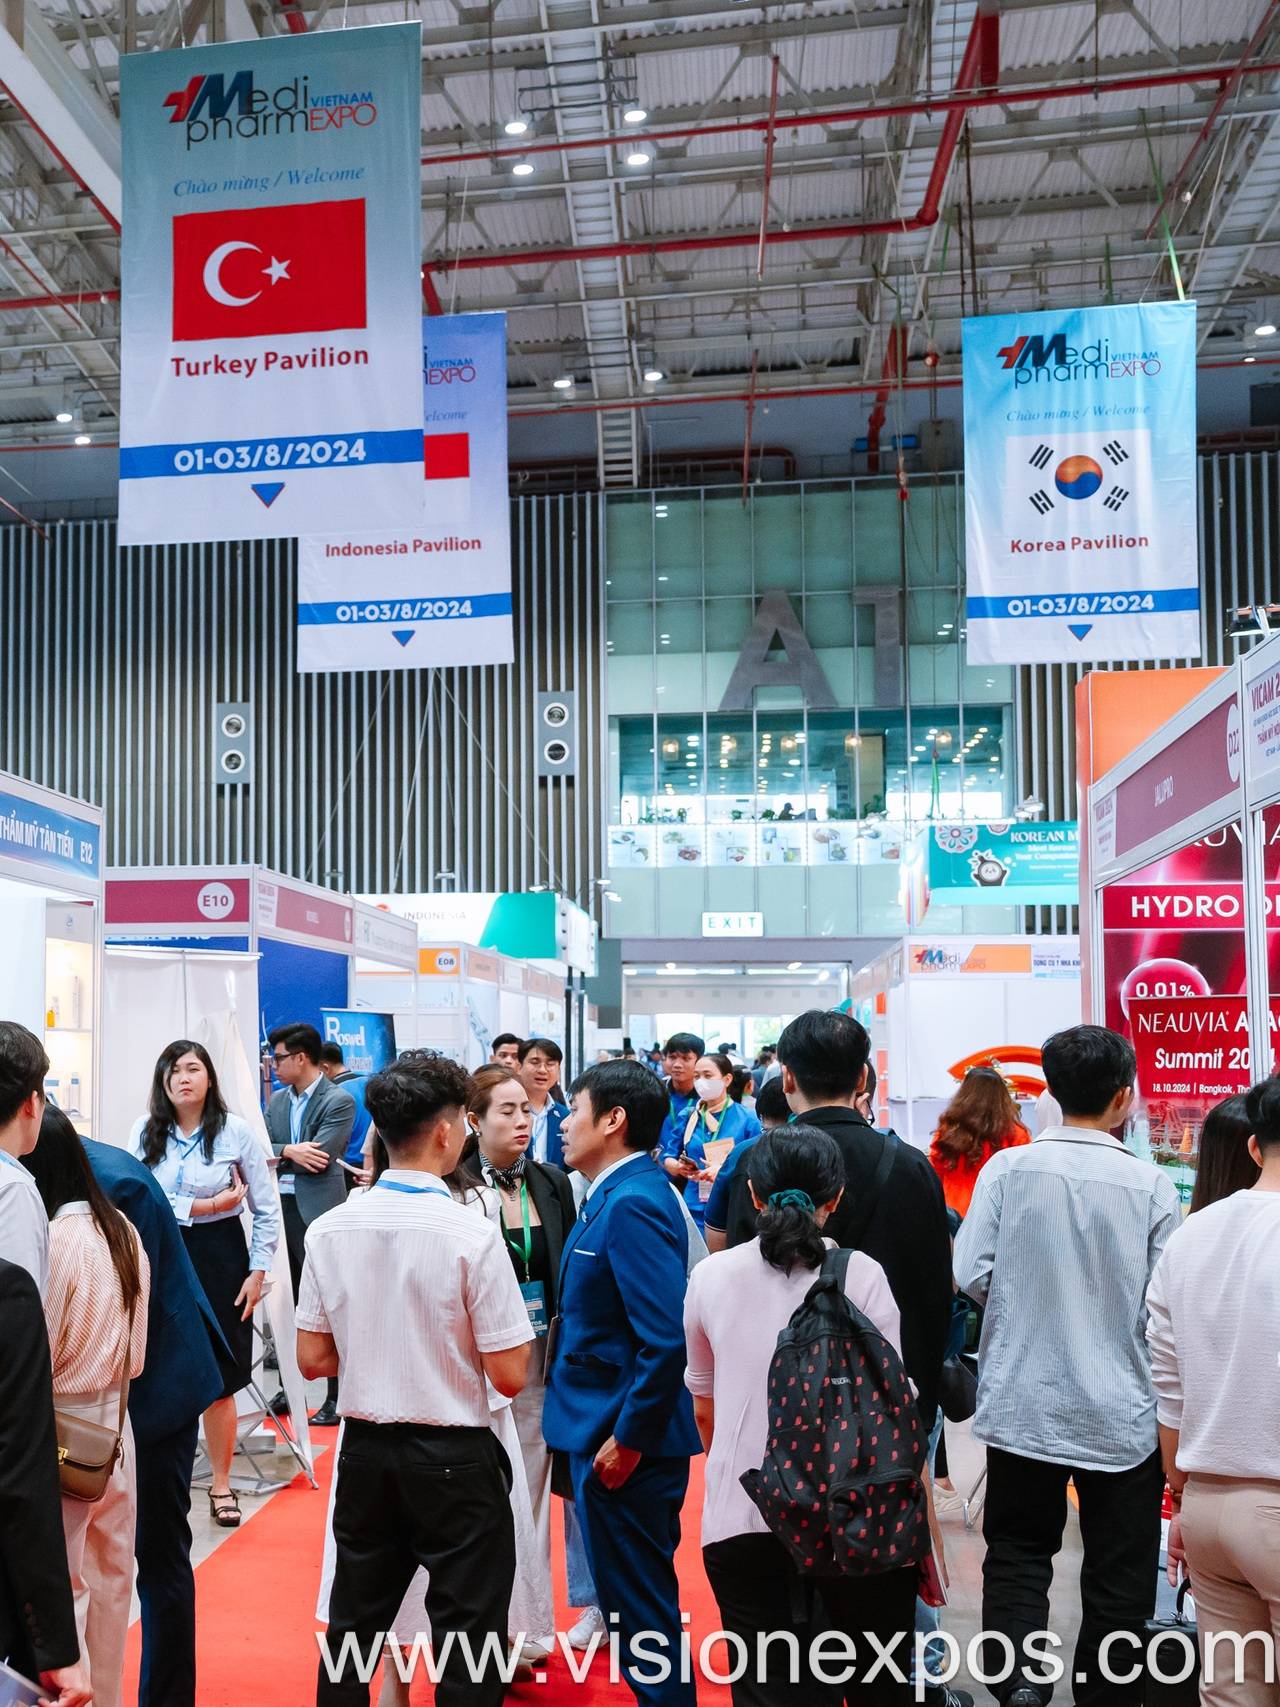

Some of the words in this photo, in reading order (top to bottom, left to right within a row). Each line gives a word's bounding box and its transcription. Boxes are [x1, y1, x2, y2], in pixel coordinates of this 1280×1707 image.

[188, 70, 309, 120] Medi
[310, 91, 374, 107] VIETNAM
[186, 108, 309, 151] pharm
[310, 103, 378, 132] EXPO
[173, 179, 217, 198] Chào
[223, 173, 269, 193] mừng
[287, 166, 365, 187] Welcome
[1015, 333, 1109, 367] Medi
[1111, 351, 1160, 362] VIETNAM
[171, 352, 258, 379] Turkey
[264, 347, 370, 372] Pavilion
[429, 358, 474, 369] VIETNAM
[1014, 361, 1110, 389] pharm
[1110, 359, 1162, 379] EXPO
[429, 365, 476, 385] EXPO
[423, 410, 468, 422] elcome
[1092, 404, 1151, 418] Welcome
[173, 438, 367, 473] 01-03/8/2024
[324, 540, 409, 558] Indonesia
[412, 536, 482, 554] Pavilion
[1010, 538, 1066, 553] Korea
[1071, 534, 1149, 551] Pavilion
[335, 599, 473, 622] 01-03/8/2024
[1007, 593, 1155, 616] 01-03/8/2024
[1251, 676, 1274, 712] VICAM
[39, 824, 57, 853] TÂN
[57, 829, 75, 859] TIẾN
[1010, 831, 1065, 843] KOREAN
[80, 840, 94, 865] E12
[202, 895, 229, 907] E10
[1131, 895, 1240, 918] HYDRO
[708, 916, 758, 931] EXIT
[438, 957, 455, 966] E08
[1135, 982, 1196, 998] 0.01%
[1138, 1011, 1229, 1033] NEAUVIA
[1154, 1048, 1224, 1070] Summit
[1153, 1083, 1191, 1093] 18.10.2024
